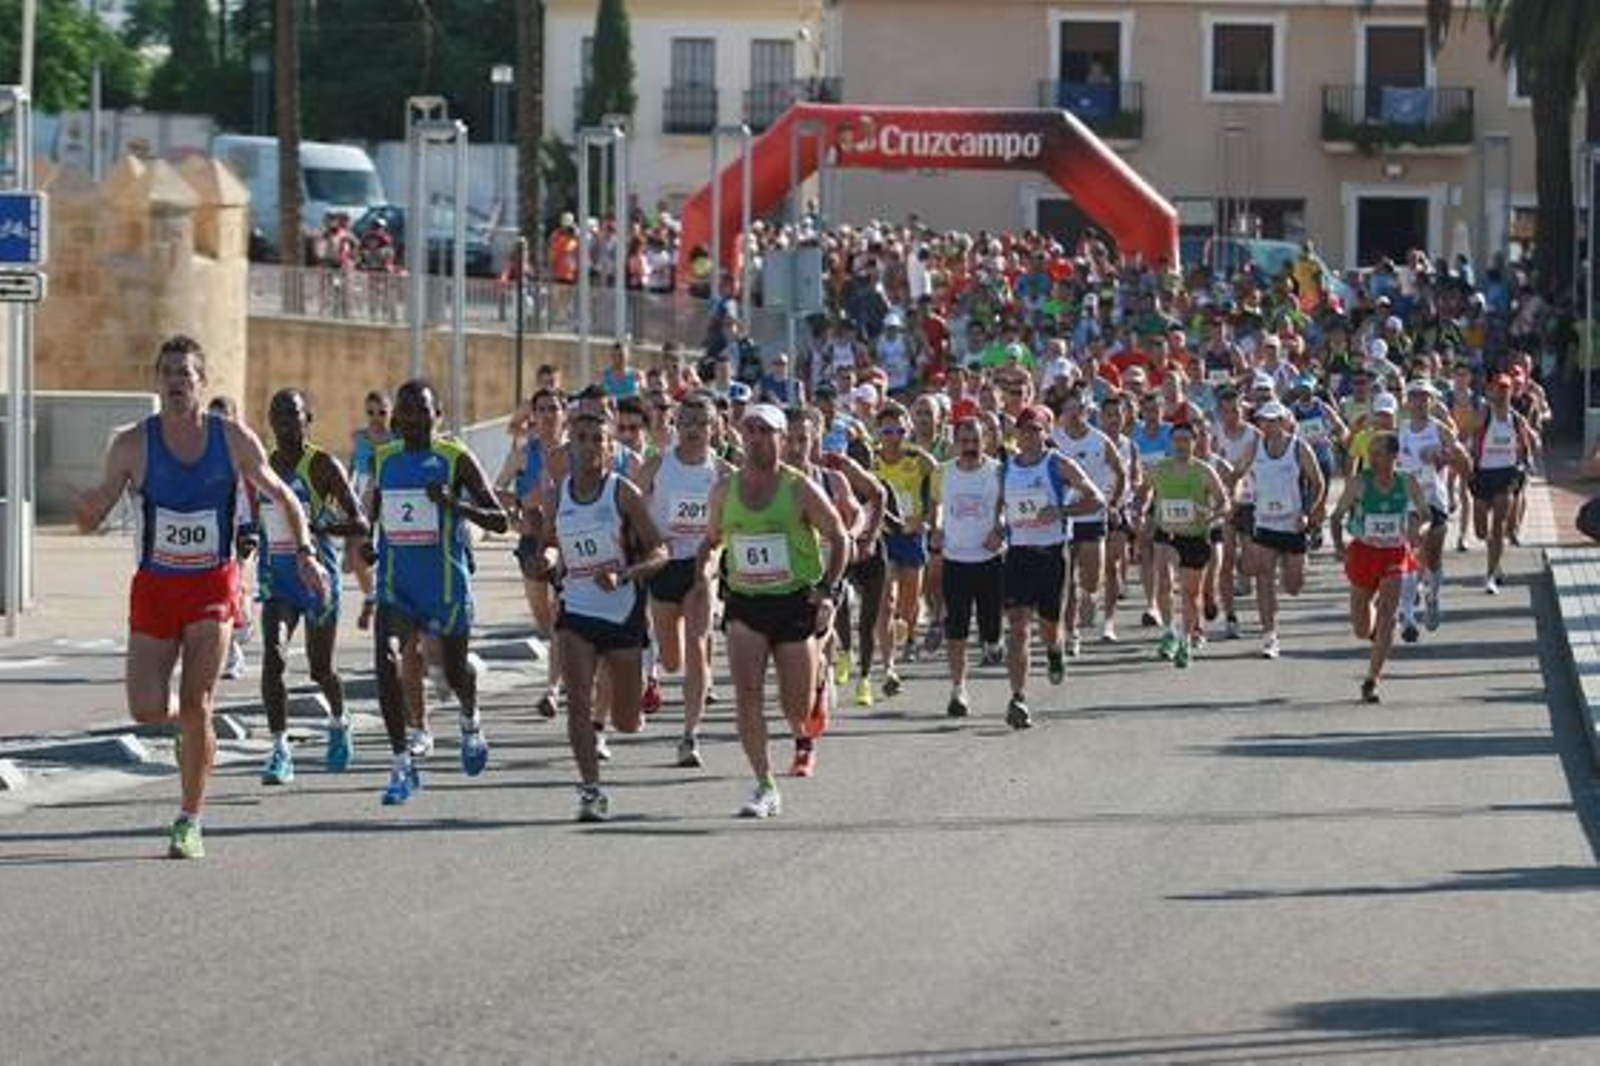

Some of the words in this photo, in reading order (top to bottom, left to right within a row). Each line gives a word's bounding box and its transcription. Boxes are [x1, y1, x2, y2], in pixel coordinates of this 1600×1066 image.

[879, 124, 1042, 163] Cruzcampo
[401, 501, 414, 523] 2
[678, 501, 706, 518] 201
[165, 524, 206, 546] 290
[573, 539, 598, 557] 10
[747, 547, 769, 566] 61
